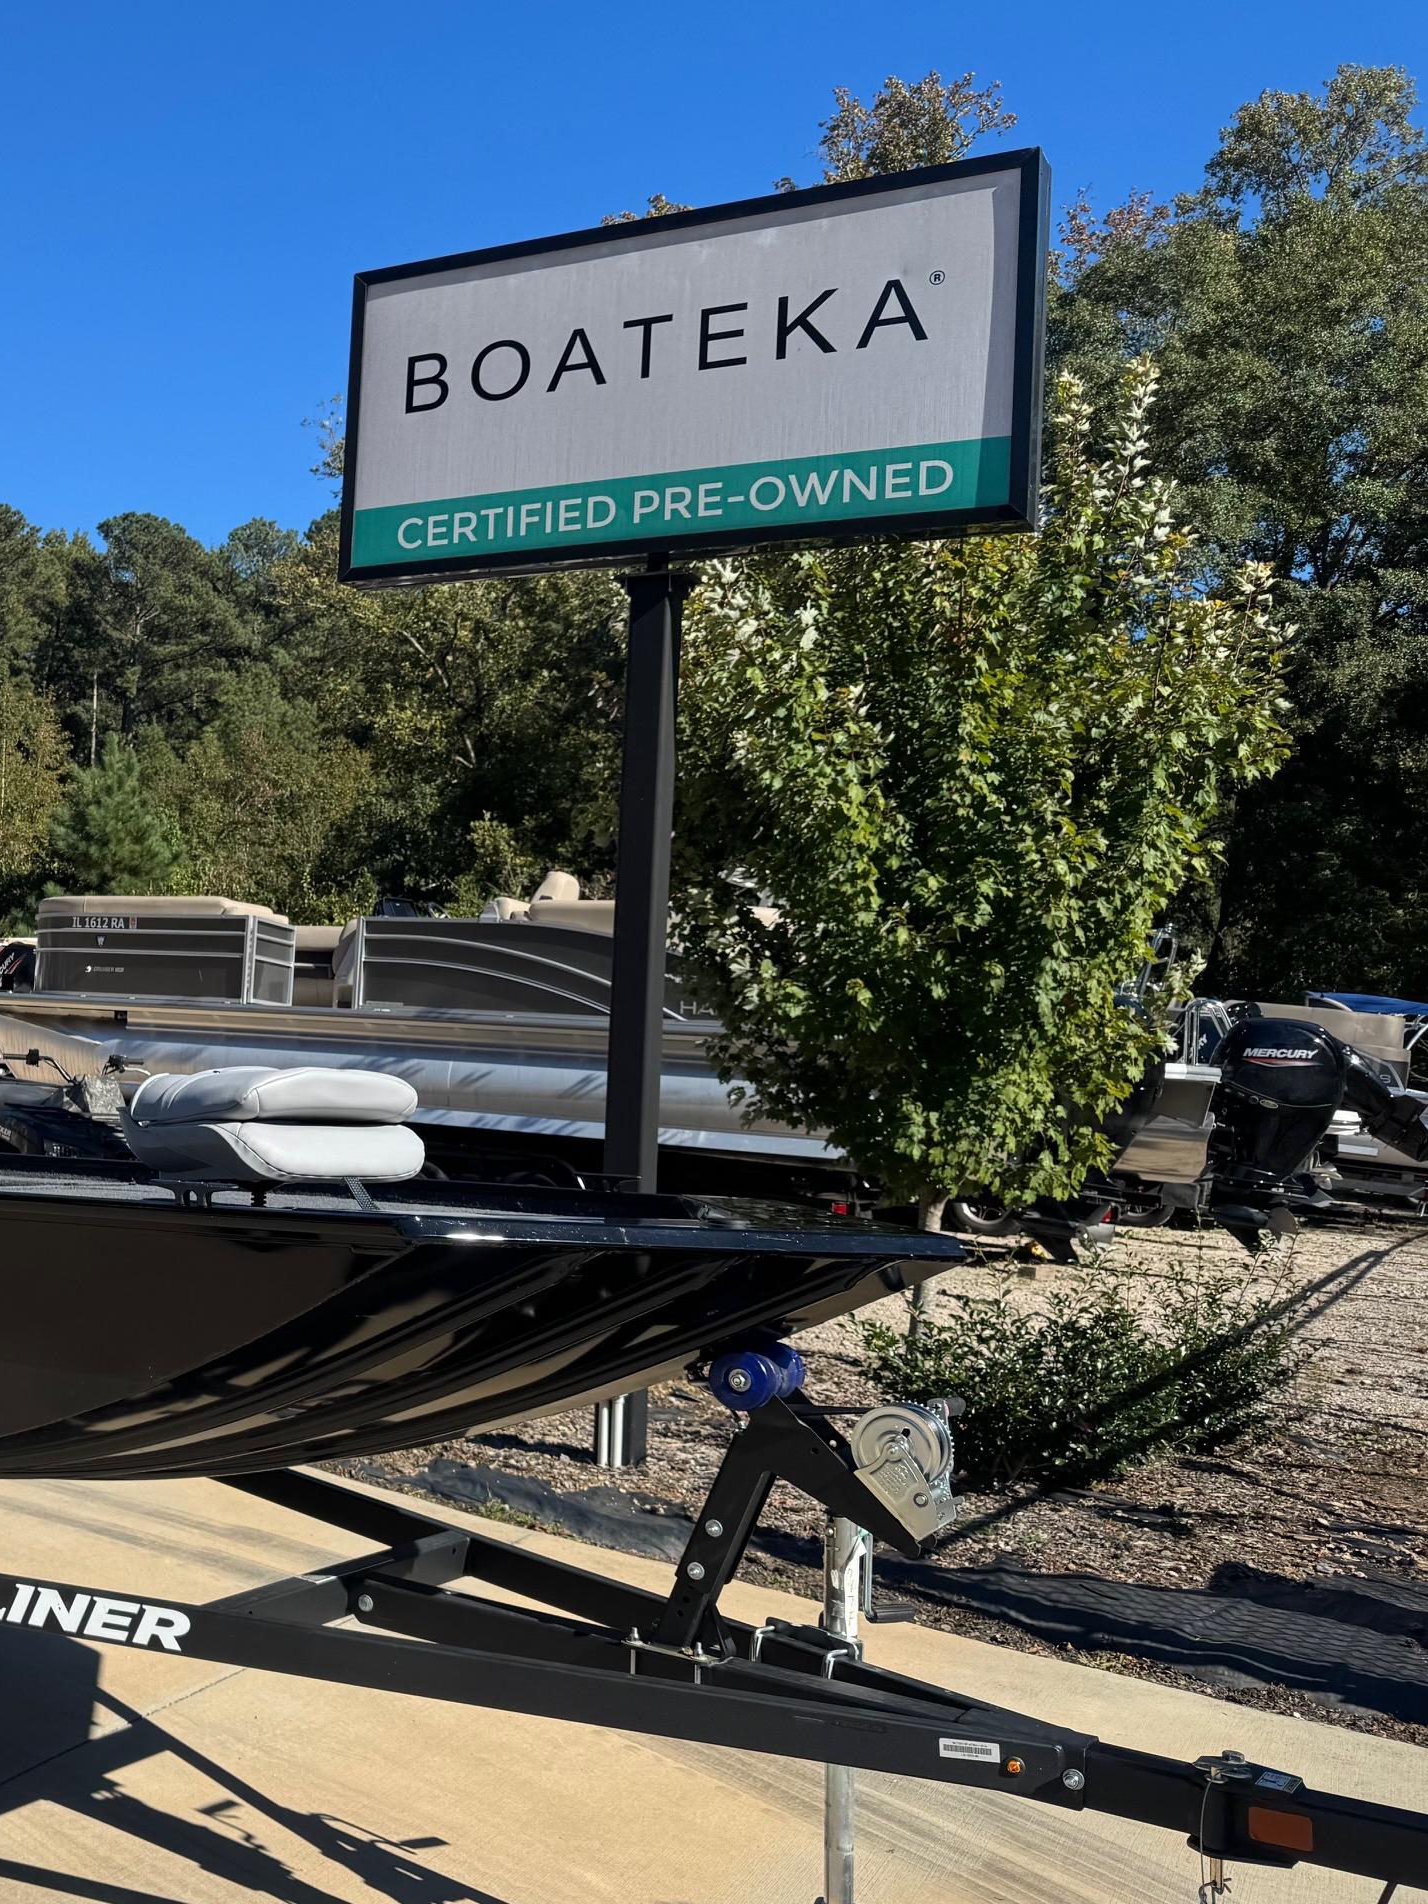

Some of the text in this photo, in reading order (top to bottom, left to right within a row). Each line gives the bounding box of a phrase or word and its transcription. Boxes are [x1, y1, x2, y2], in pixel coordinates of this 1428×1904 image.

[397, 459, 955, 550] CERTIFIED PRE-OWNED
[71, 916, 125, 929] IL 1612 RA
[1243, 1047, 1319, 1060] MERCURY
